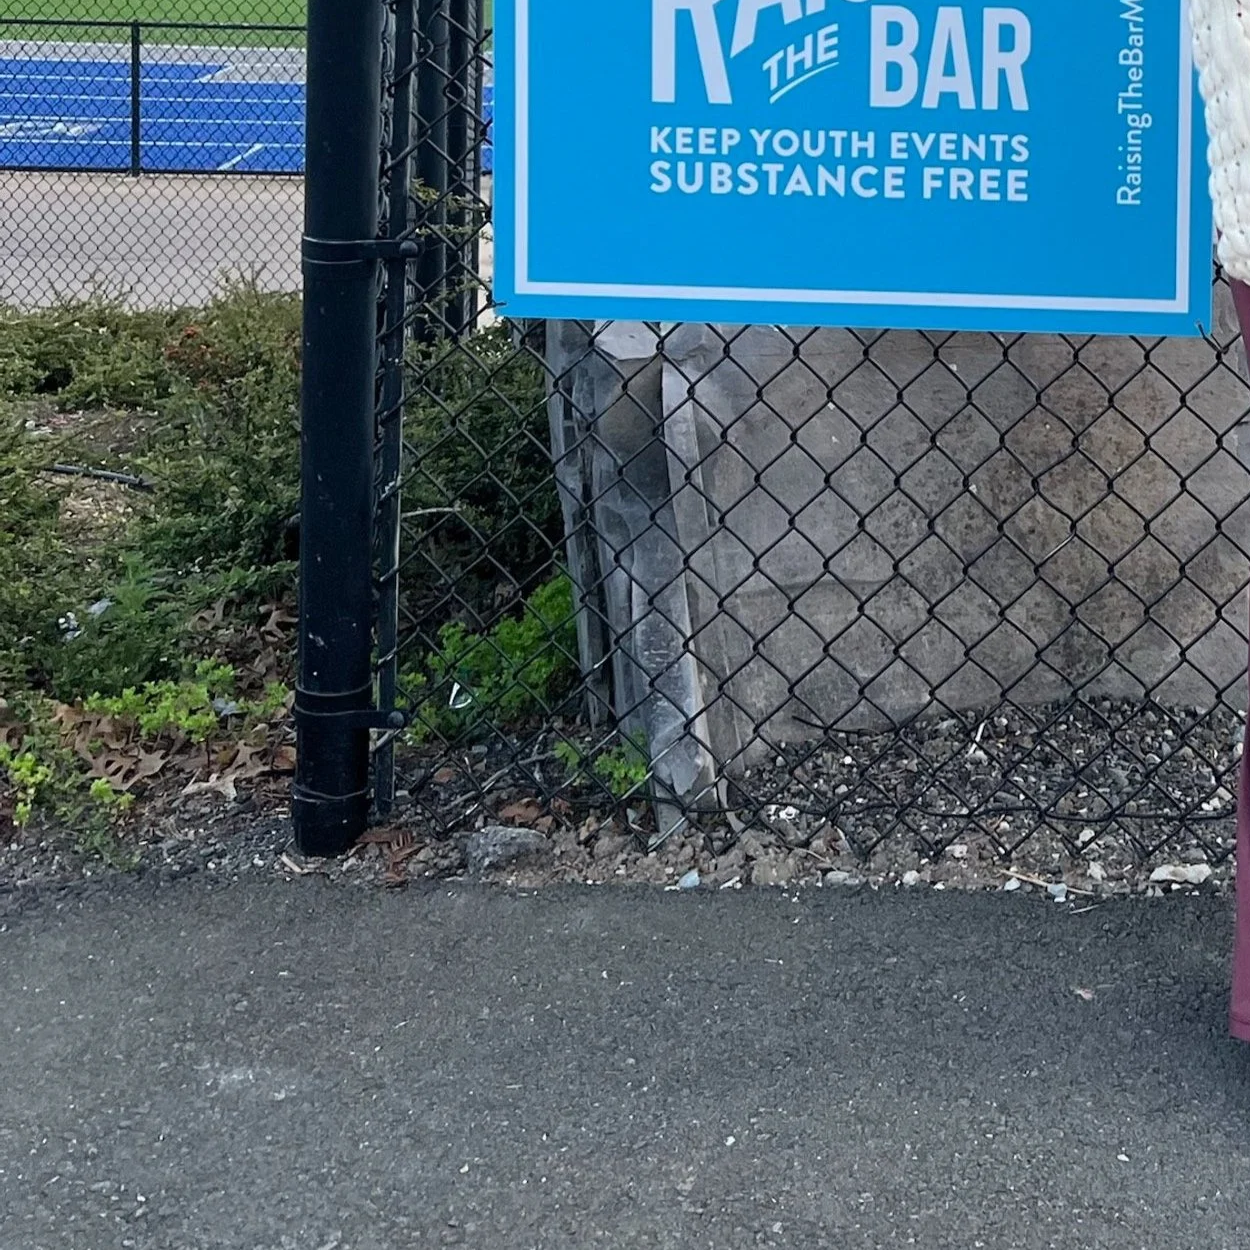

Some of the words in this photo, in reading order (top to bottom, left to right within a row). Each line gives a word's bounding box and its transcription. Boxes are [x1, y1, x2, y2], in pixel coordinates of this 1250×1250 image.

[762, 22, 840, 91] THE
[869, 4, 1032, 111] BAR
[650, 126, 741, 155] KEEP
[749, 128, 876, 159] YOUTH
[889, 131, 1030, 163] EVENTS
[649, 160, 906, 199] SUBSTANCE
[922, 166, 1030, 202] FREE
